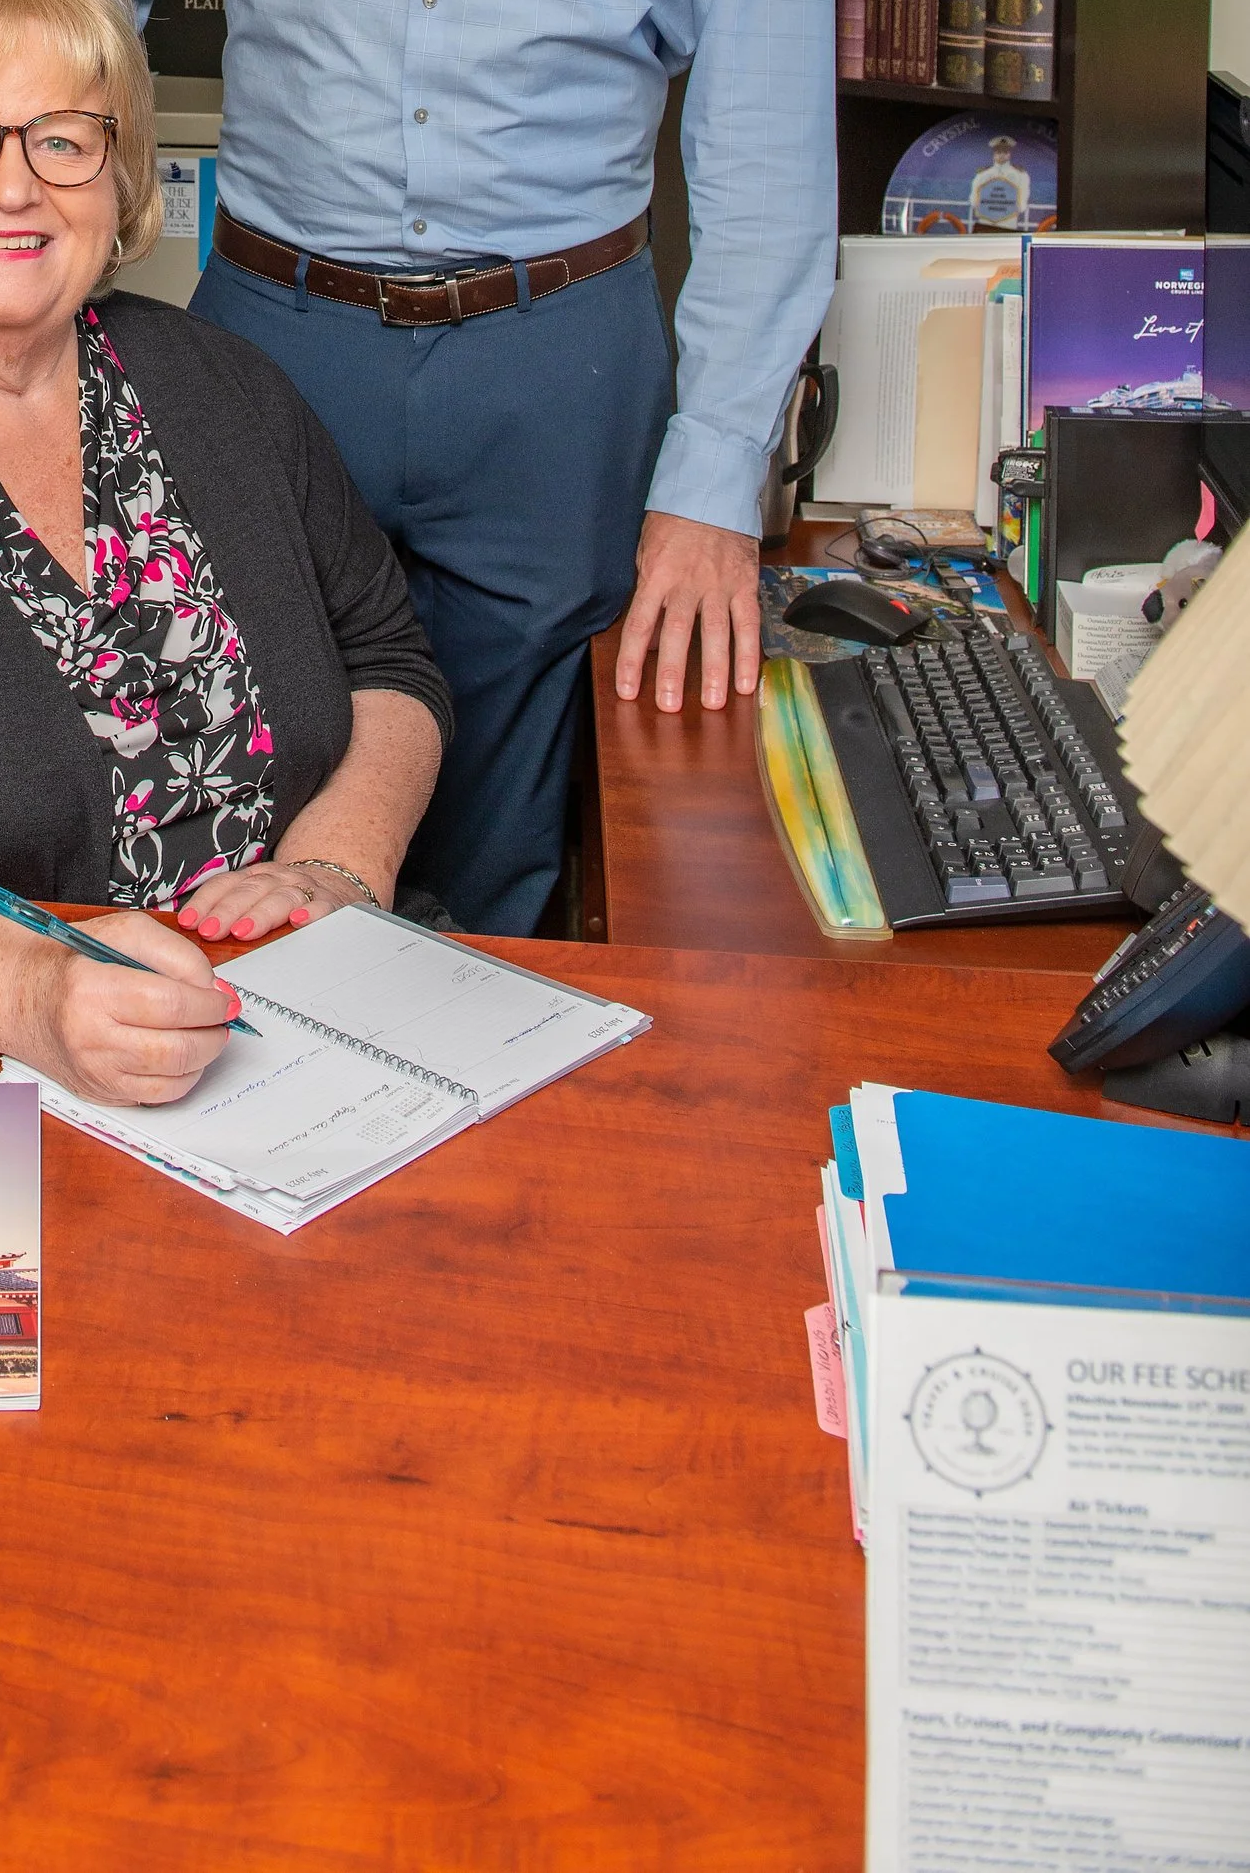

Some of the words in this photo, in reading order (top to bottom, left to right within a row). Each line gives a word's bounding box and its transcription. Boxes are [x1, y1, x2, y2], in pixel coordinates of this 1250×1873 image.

[163, 197, 192, 208] RUISE
[1133, 315, 1182, 340] Live
[605, 1017, 623, 1030] July
[588, 1025, 609, 1039] 2023
[286, 1173, 309, 1188] 2023
[308, 1168, 329, 1179] July
[1066, 1358, 1126, 1385] OUR
[1133, 1362, 1178, 1387] FEE
